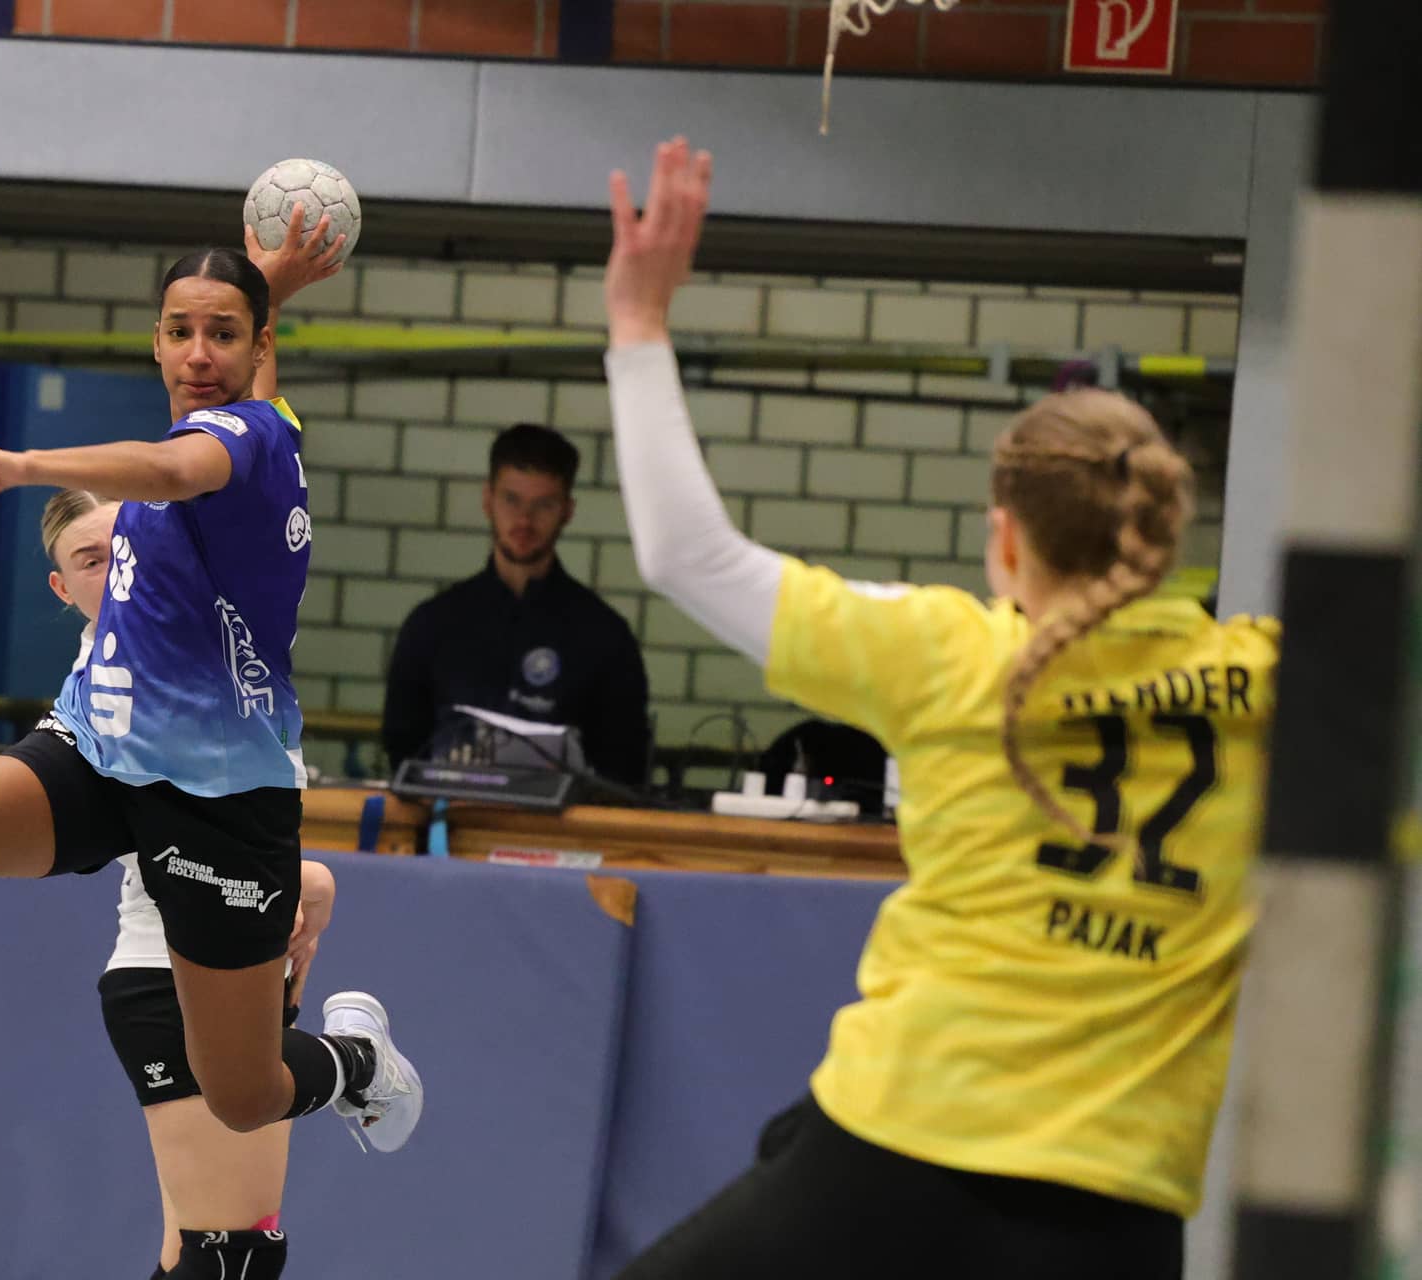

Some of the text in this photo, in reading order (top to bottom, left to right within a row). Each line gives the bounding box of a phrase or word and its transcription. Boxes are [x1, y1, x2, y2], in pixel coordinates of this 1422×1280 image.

[1035, 713, 1218, 896] 32
[166, 864, 258, 890] HOLZ IMMOBILIEN
[168, 856, 214, 876] GUNNAR
[221, 887, 264, 899] MAKLER
[225, 897, 257, 908] GMBH
[1047, 897, 1168, 962] PAJAK
